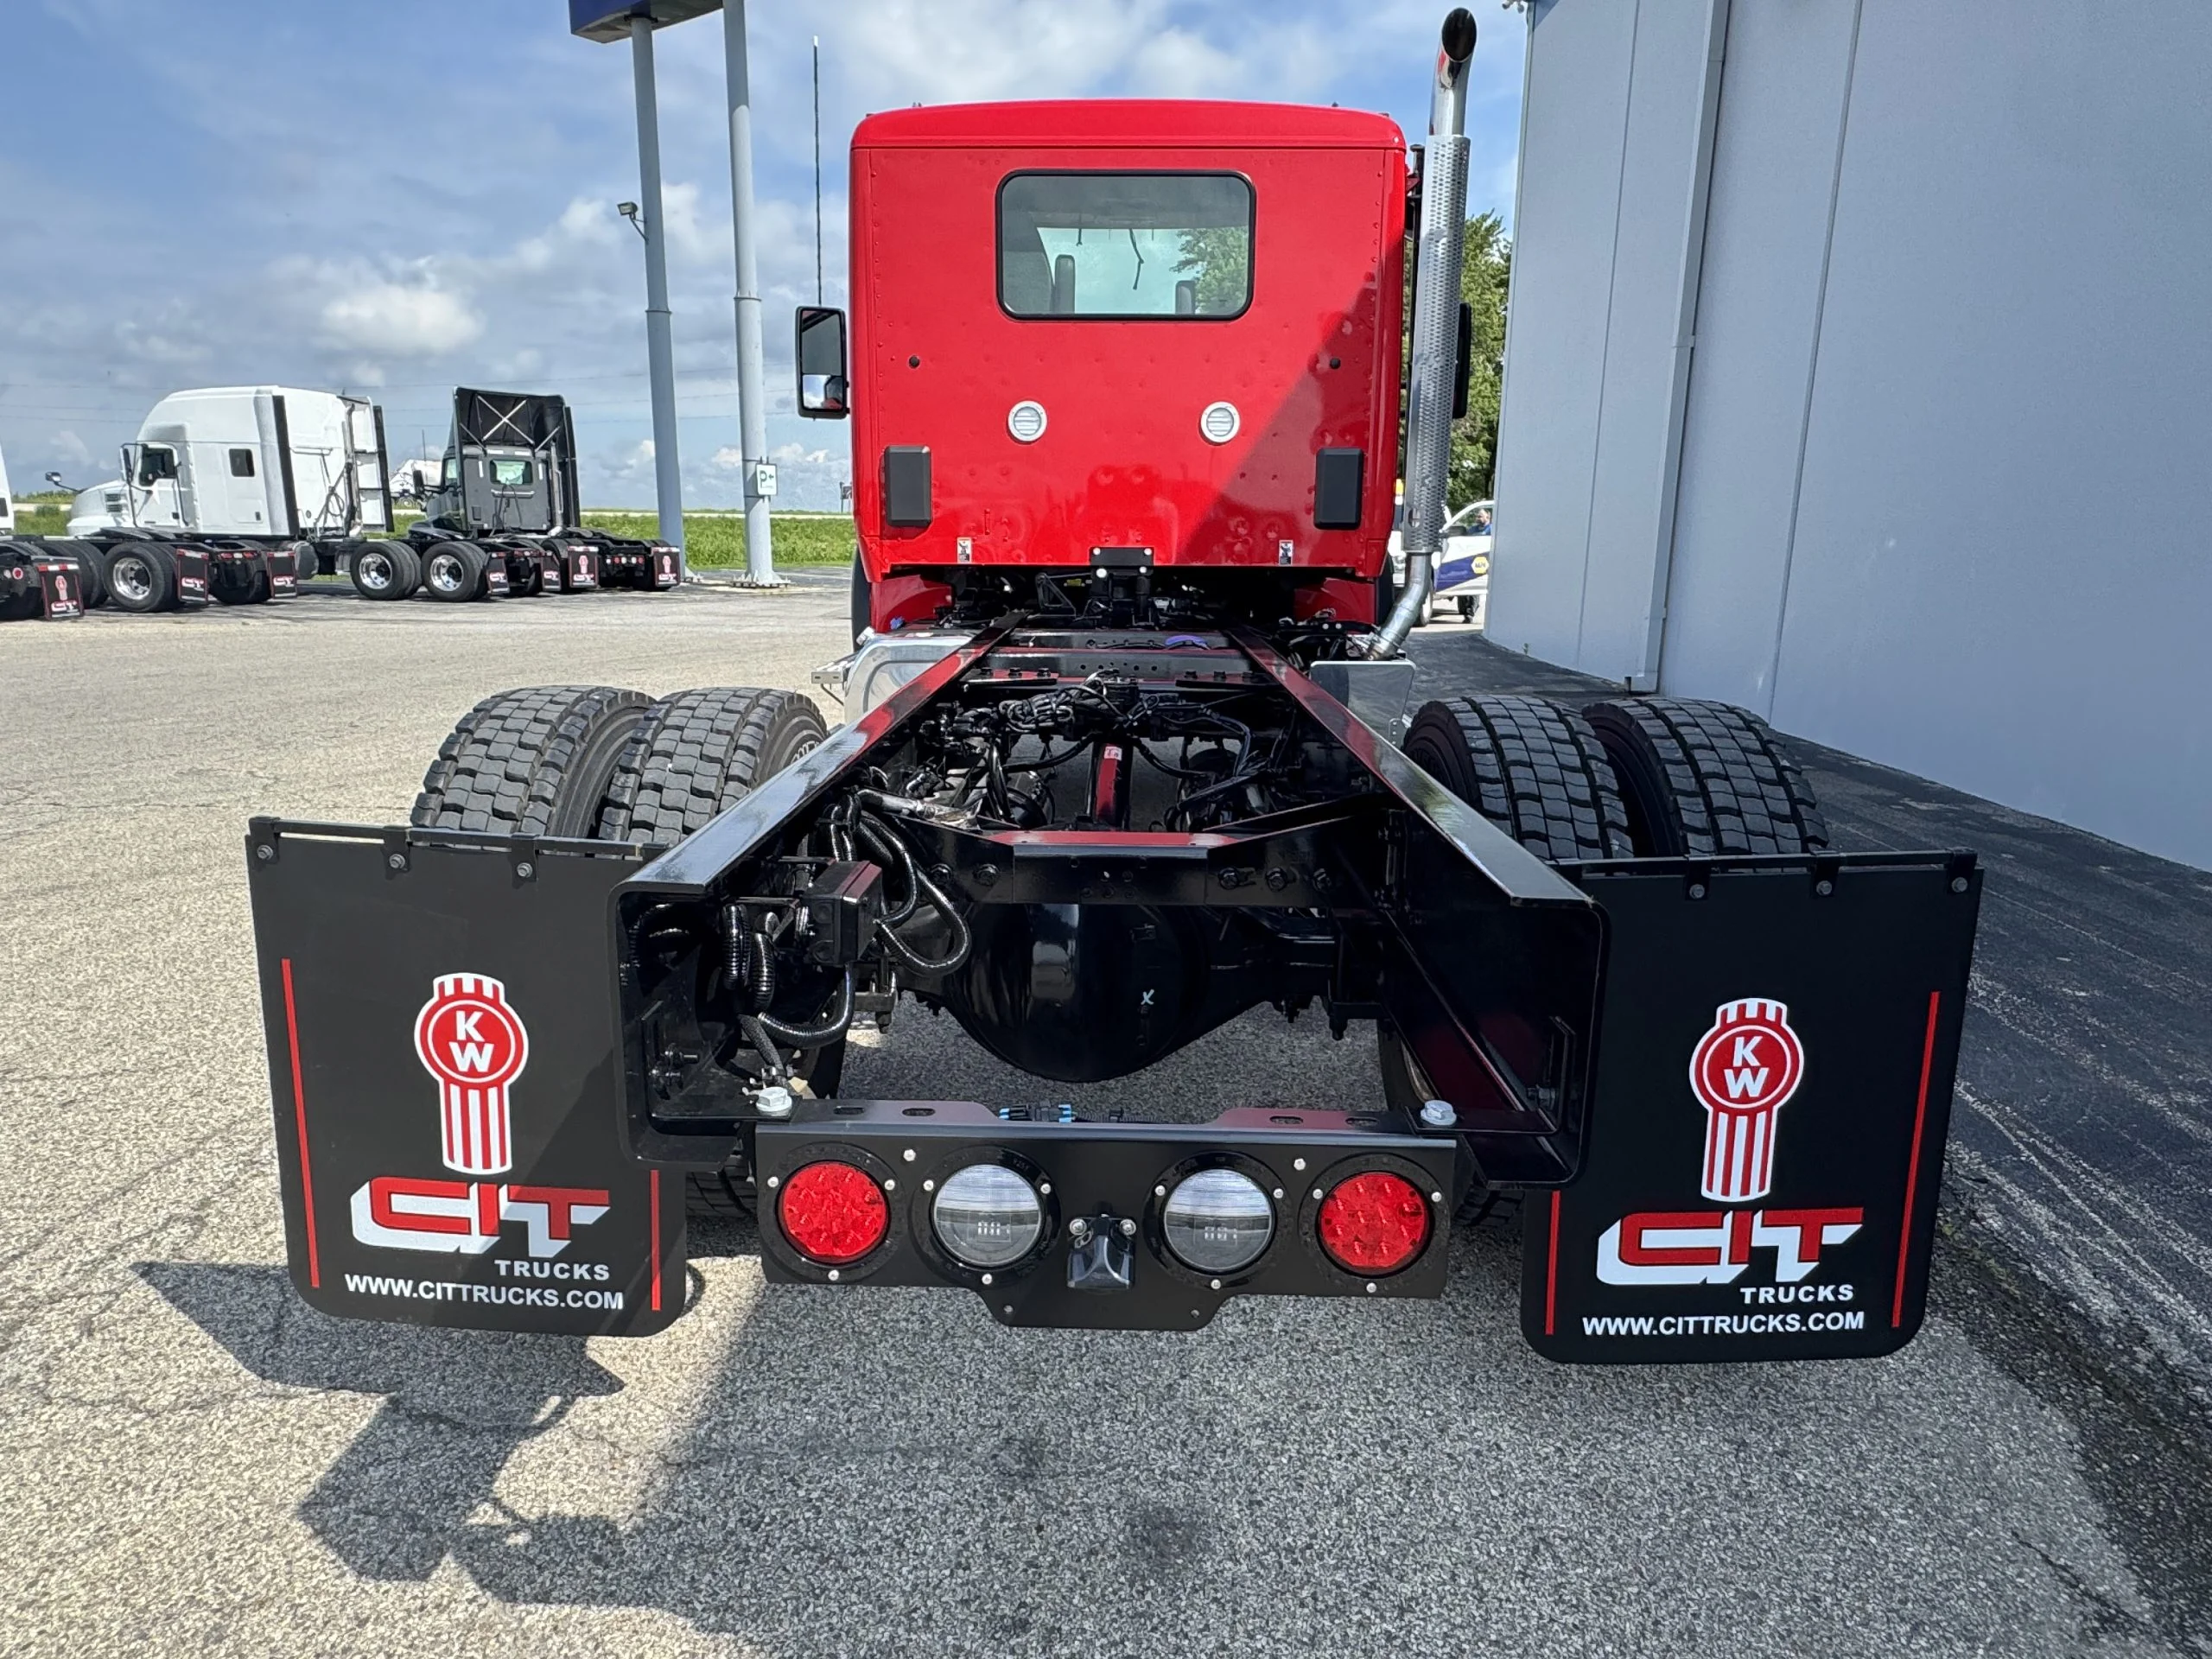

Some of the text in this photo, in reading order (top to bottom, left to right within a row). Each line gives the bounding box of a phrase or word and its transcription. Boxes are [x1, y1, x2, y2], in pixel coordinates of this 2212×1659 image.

[760, 470, 767, 488] P
[351, 1176, 611, 1257] CIT
[1596, 1206, 1865, 1286] CIT
[493, 1259, 610, 1281] TRUCKS
[345, 1273, 625, 1310] WWW.CITTRUCKS.COM
[1739, 1284, 1854, 1305] TRUCKS
[1582, 1311, 1865, 1336] WWW.CITTRUCKS.COM
